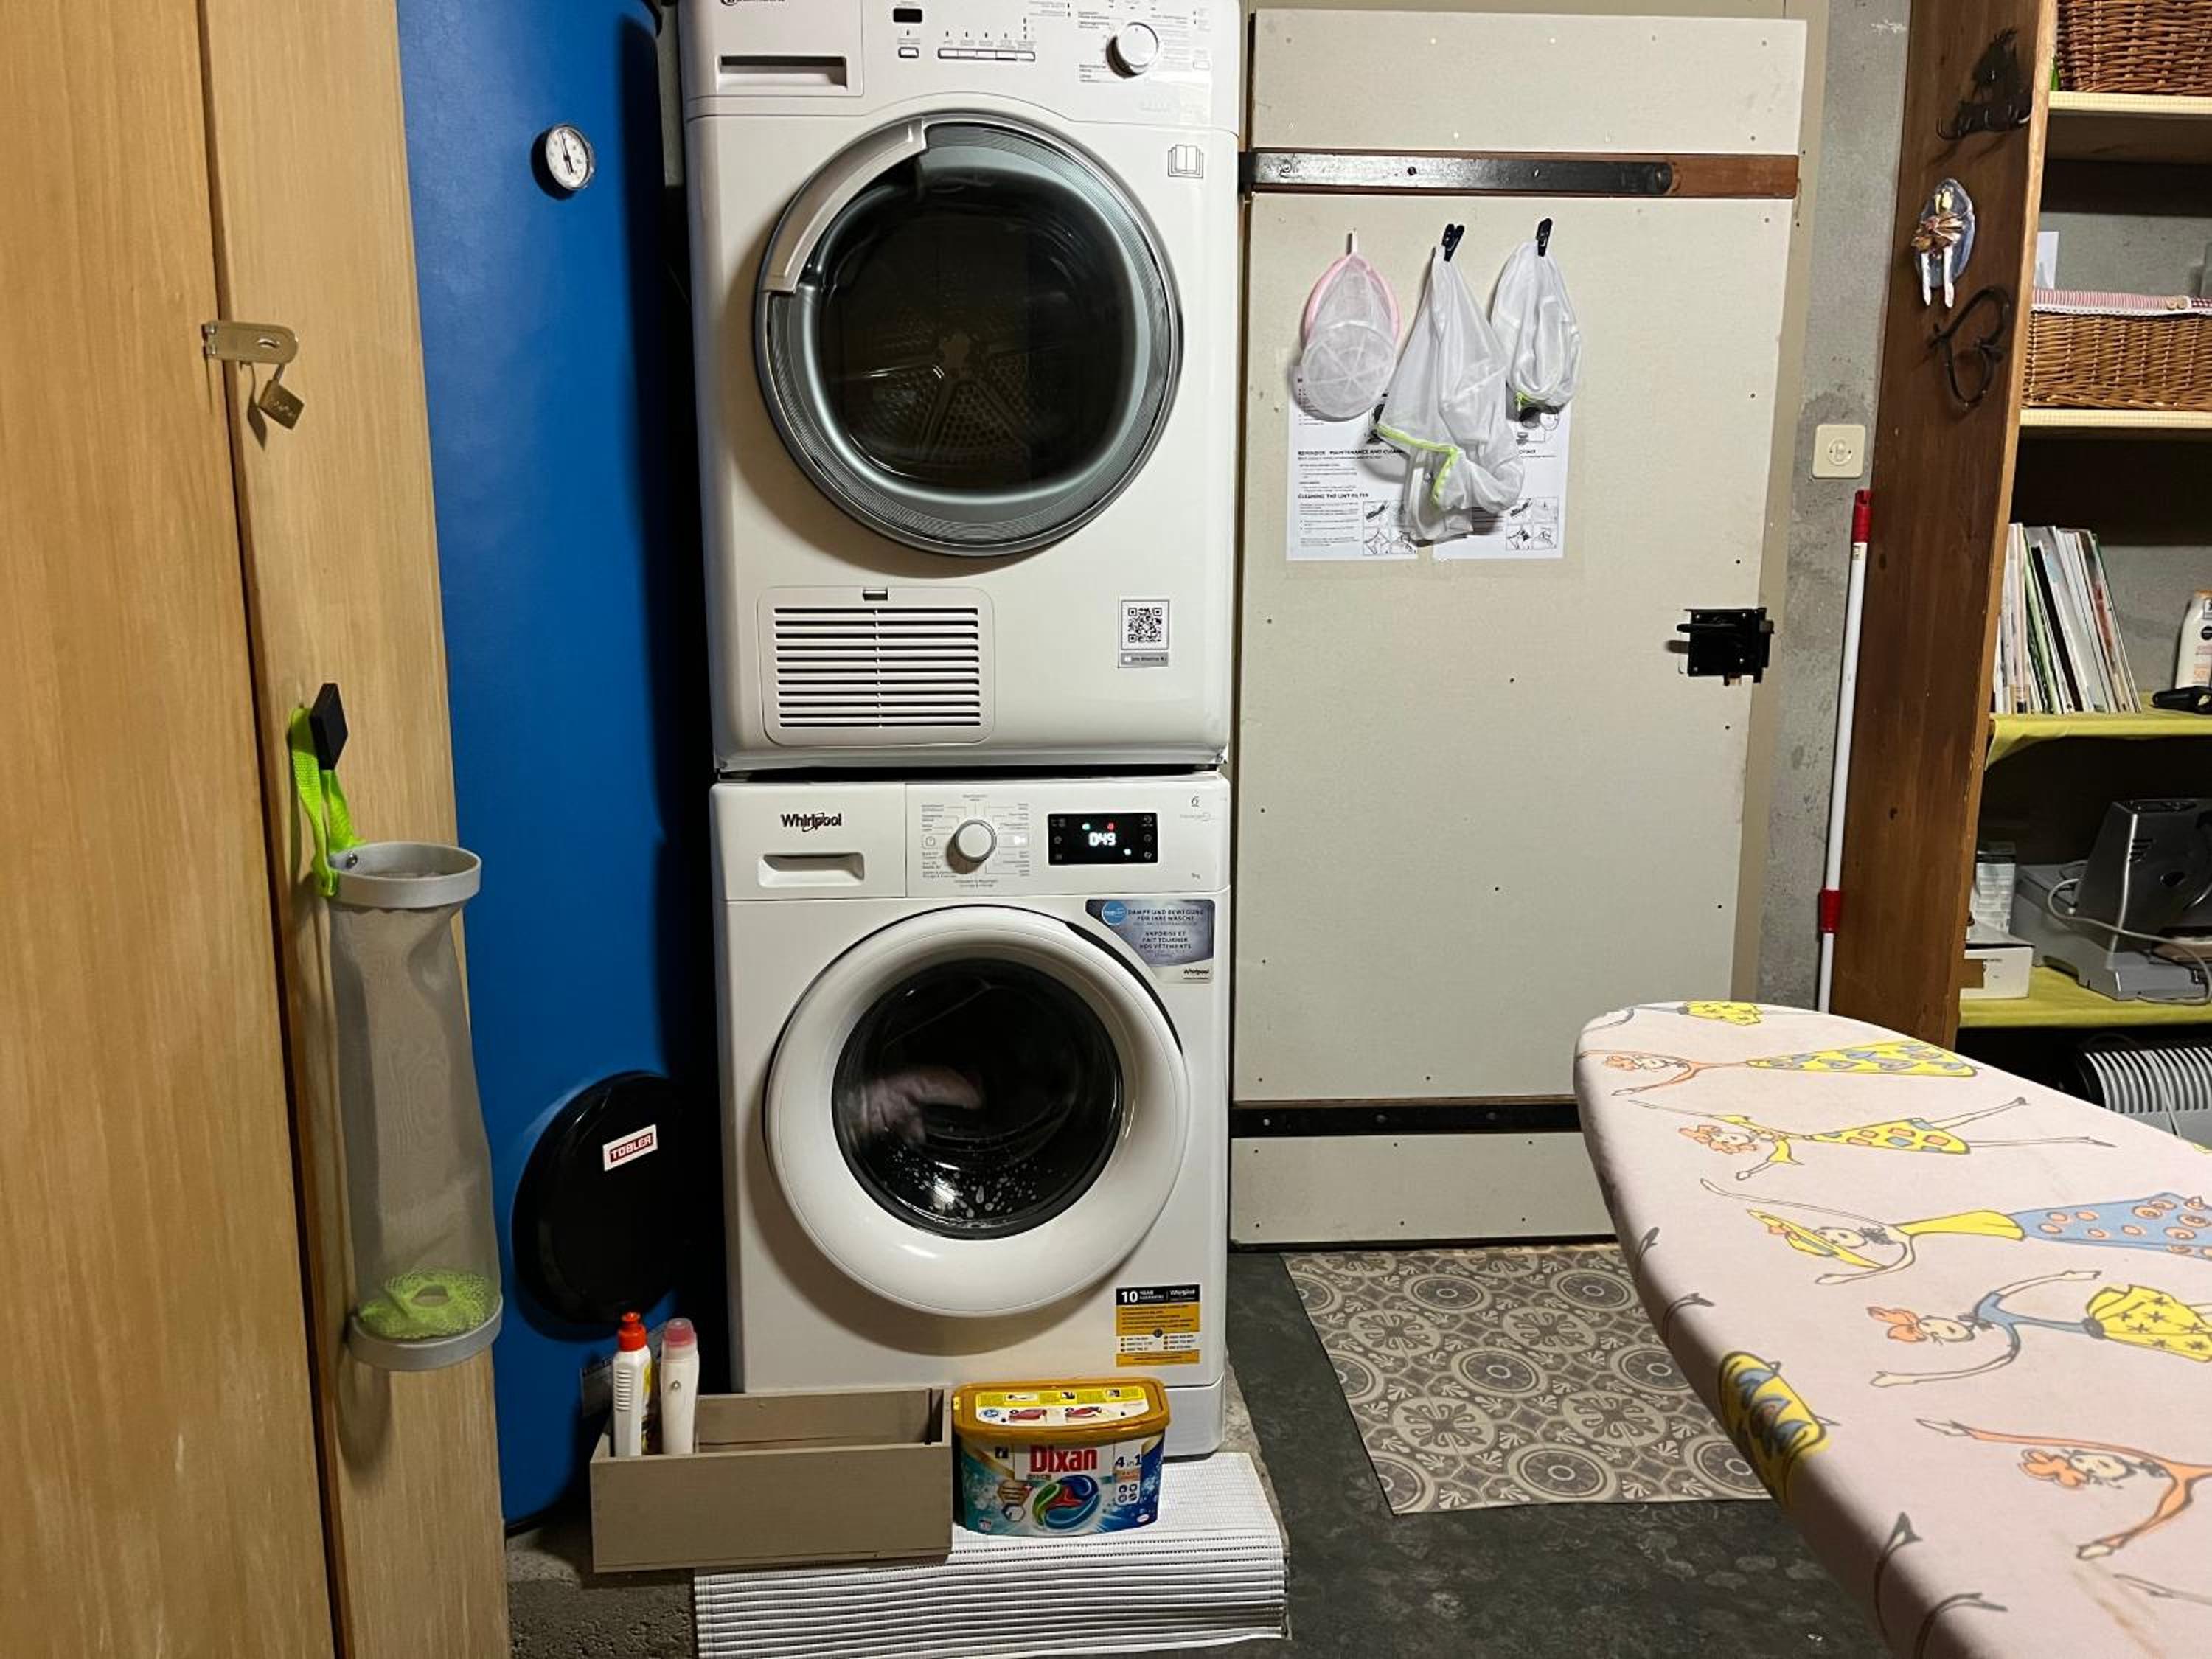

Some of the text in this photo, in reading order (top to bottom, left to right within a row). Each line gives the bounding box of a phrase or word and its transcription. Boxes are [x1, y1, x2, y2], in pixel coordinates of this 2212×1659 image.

[780, 812, 842, 832] Whirlpool
[611, 1135, 652, 1160] TOBLER
[1121, 1291, 1138, 1304] 10
[1030, 1444, 1097, 1472] Dixan
[1114, 1456, 1125, 1468] 4
